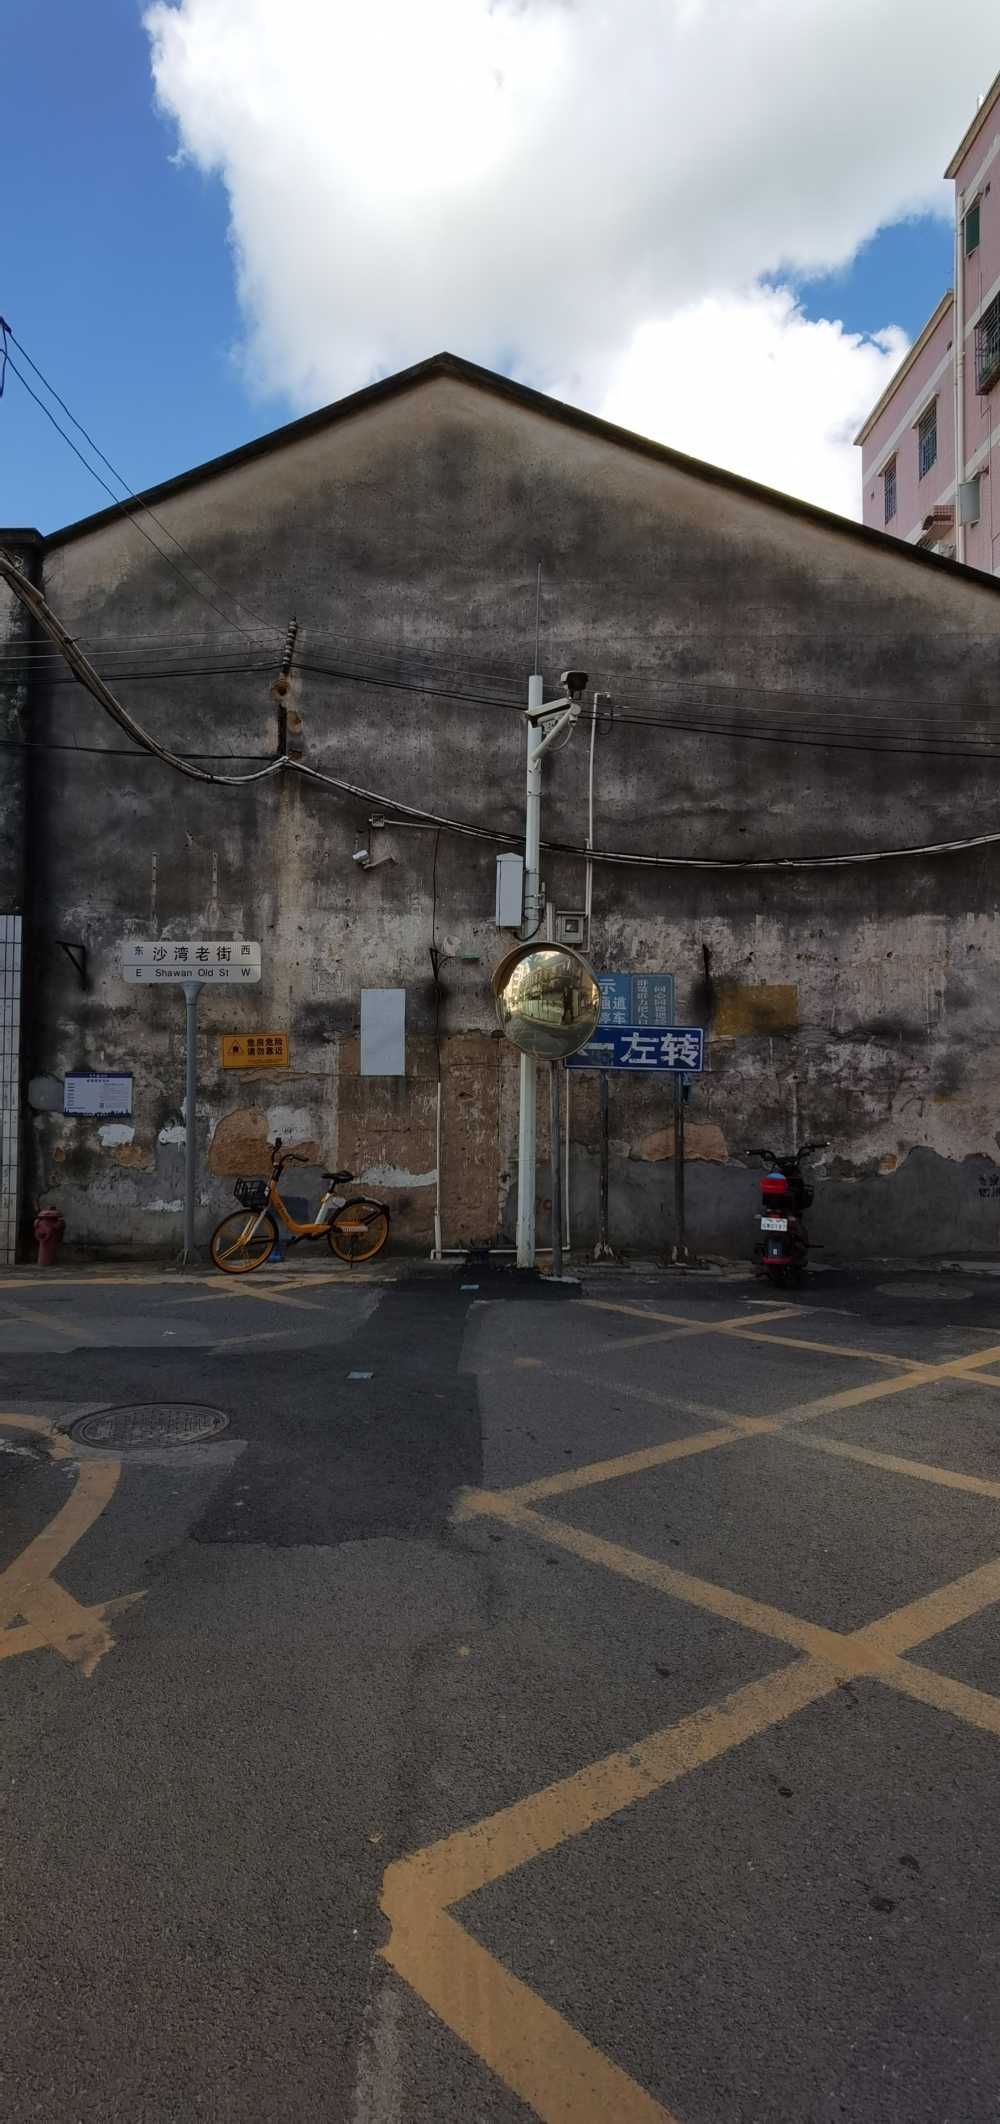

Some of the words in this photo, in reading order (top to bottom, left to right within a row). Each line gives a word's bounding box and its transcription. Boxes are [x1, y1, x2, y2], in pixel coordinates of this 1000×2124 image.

[152, 945, 232, 962] 沙湾老街
[240, 944, 251, 956] 西
[135, 968, 142, 977] E
[155, 968, 193, 977] Shawan
[198, 968, 214, 977] Old
[219, 968, 229, 977] St
[241, 968, 251, 977] W
[619, 1031, 700, 1067] 左转
